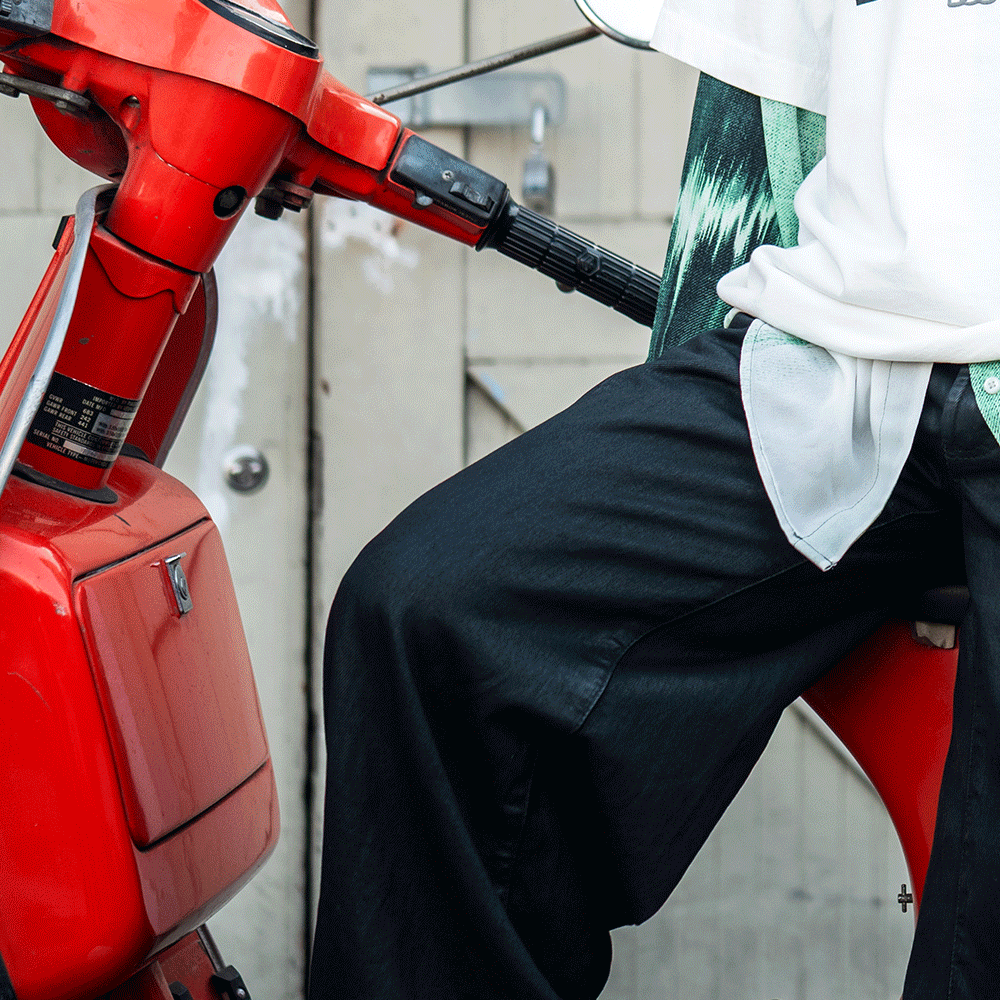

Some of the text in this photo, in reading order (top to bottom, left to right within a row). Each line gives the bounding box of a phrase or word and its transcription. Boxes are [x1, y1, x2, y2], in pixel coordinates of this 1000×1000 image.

[46, 400, 78, 417] GAWR FRONT
[82, 399, 96, 408] DATE
[43, 406, 73, 421] GAWR REAR
[79, 414, 92, 423] 242
[54, 421, 67, 431] THIS
[66, 425, 87, 438] VEHICLE
[77, 420, 88, 429] 441
[33, 429, 52, 440] SERIAL
[52, 427, 70, 438] SAFETY
[46, 441, 67, 454] VEHICLE
